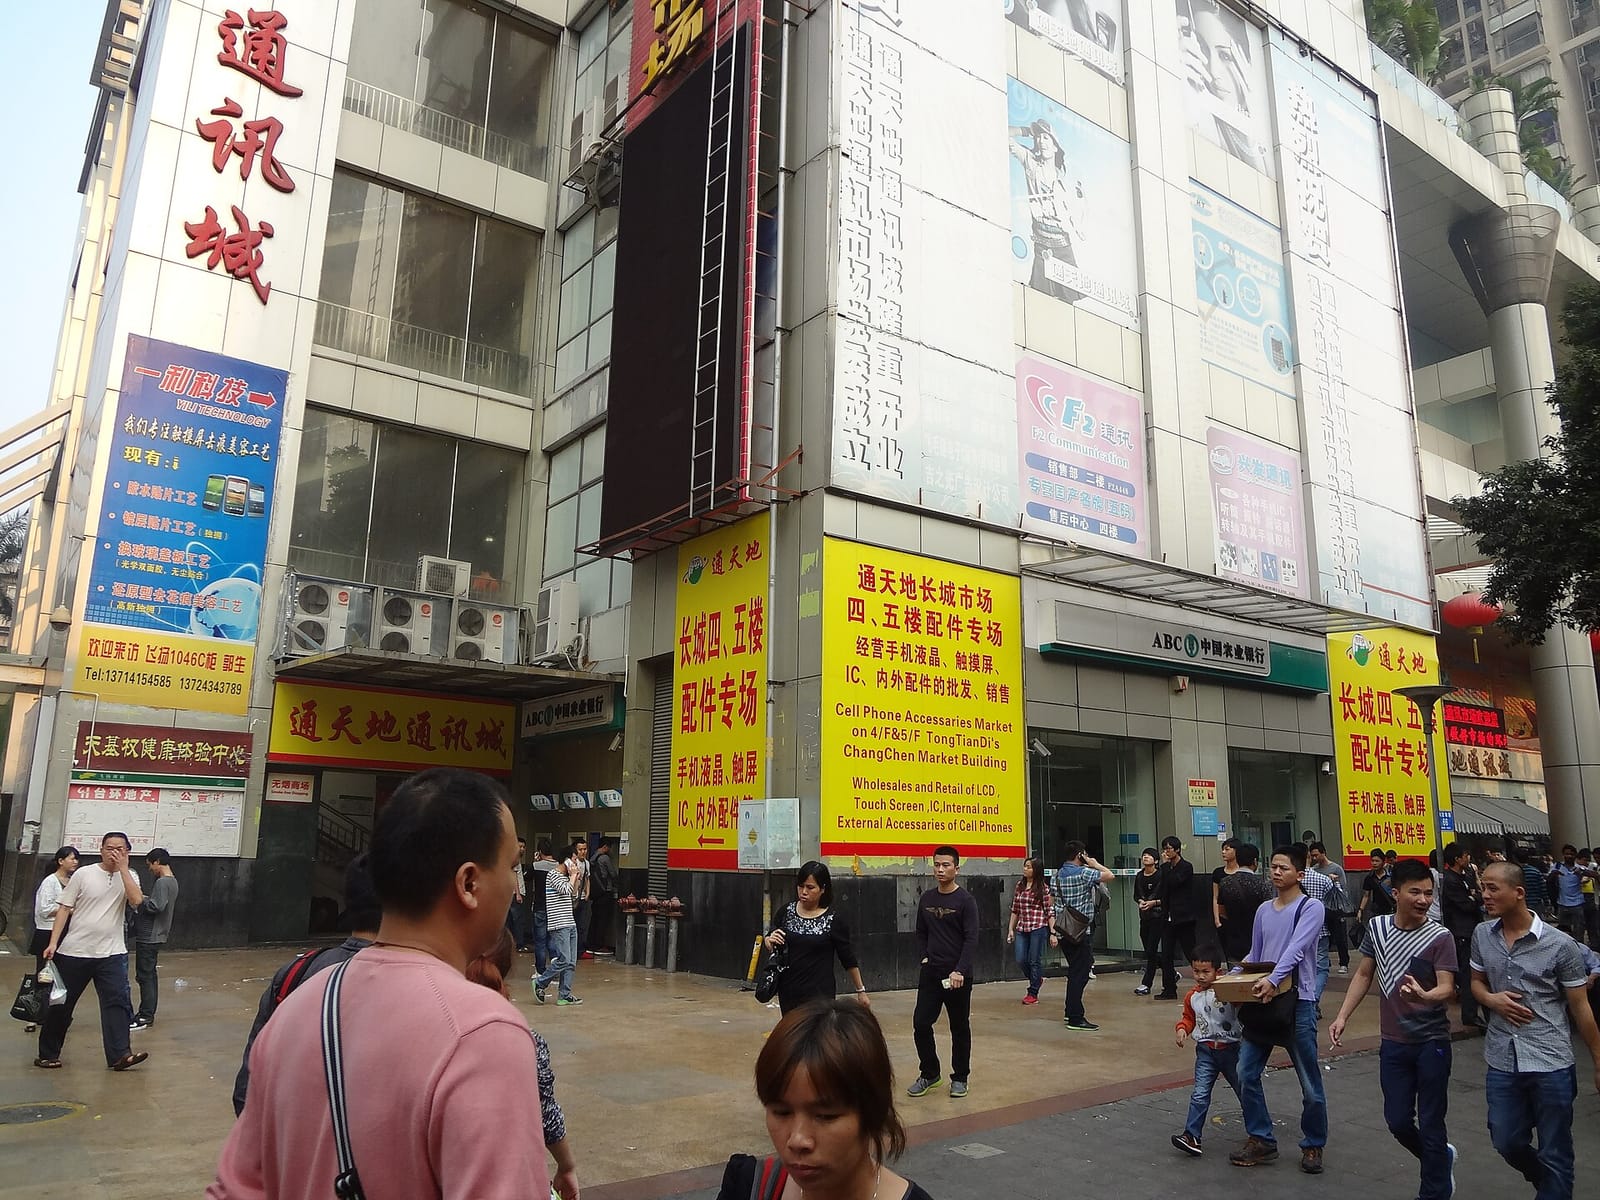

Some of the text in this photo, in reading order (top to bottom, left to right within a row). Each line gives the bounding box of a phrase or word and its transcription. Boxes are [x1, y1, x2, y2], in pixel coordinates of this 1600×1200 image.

[184, 8, 303, 305] 通讯城
[134, 364, 248, 406] 一利科技
[177, 399, 272, 429] YILI TECHNOLOGY
[1047, 459, 1079, 481] 销售部
[1086, 471, 1105, 489] 二楼
[1049, 508, 1120, 539] 售后中心 四楼
[711, 540, 762, 576] 通天地
[858, 564, 993, 614] 通天地长城市场
[679, 595, 764, 668] 长城四、五楼
[847, 597, 1003, 648] 四、五楼配件专场
[87, 638, 247, 674] 欢迎来访 飞扬1046C柜 郭生
[856, 636, 1000, 676] 经营手机液晶、触摸屏、
[1151, 632, 1266, 665] ABC 中国农业银行
[1378, 641, 1427, 675] 通天地
[85, 667, 242, 695] Tel:13714154585 13724343789
[845, 665, 1010, 704] IC、内外配件的批发、销售
[525, 695, 605, 731] ABC 中国农业银行
[680, 669, 759, 735] 配件专场
[836, 703, 1013, 733] Cell Phone Accessaries Market
[289, 700, 507, 758] 通天地通讯城
[852, 727, 1000, 750] on 4/F&5/F TongTianDi's
[677, 751, 757, 789] 手机液晶、触屏
[843, 745, 1008, 772] ChangChen Market Building
[1350, 734, 1430, 778] 配件专场
[852, 777, 913, 793] Wholesales
[915, 782, 933, 794] and
[935, 782, 963, 795] Retail
[965, 784, 975, 796] of
[1348, 791, 1426, 816] 手机液晶、触屏
[678, 795, 754, 831] IC、内外配件
[854, 797, 887, 811] Touch
[889, 799, 924, 812] Screen
[982, 803, 999, 815] and
[837, 816, 1013, 833] External Accessaries of Cell Phones
[1352, 822, 1426, 846] IC、内外配件等
